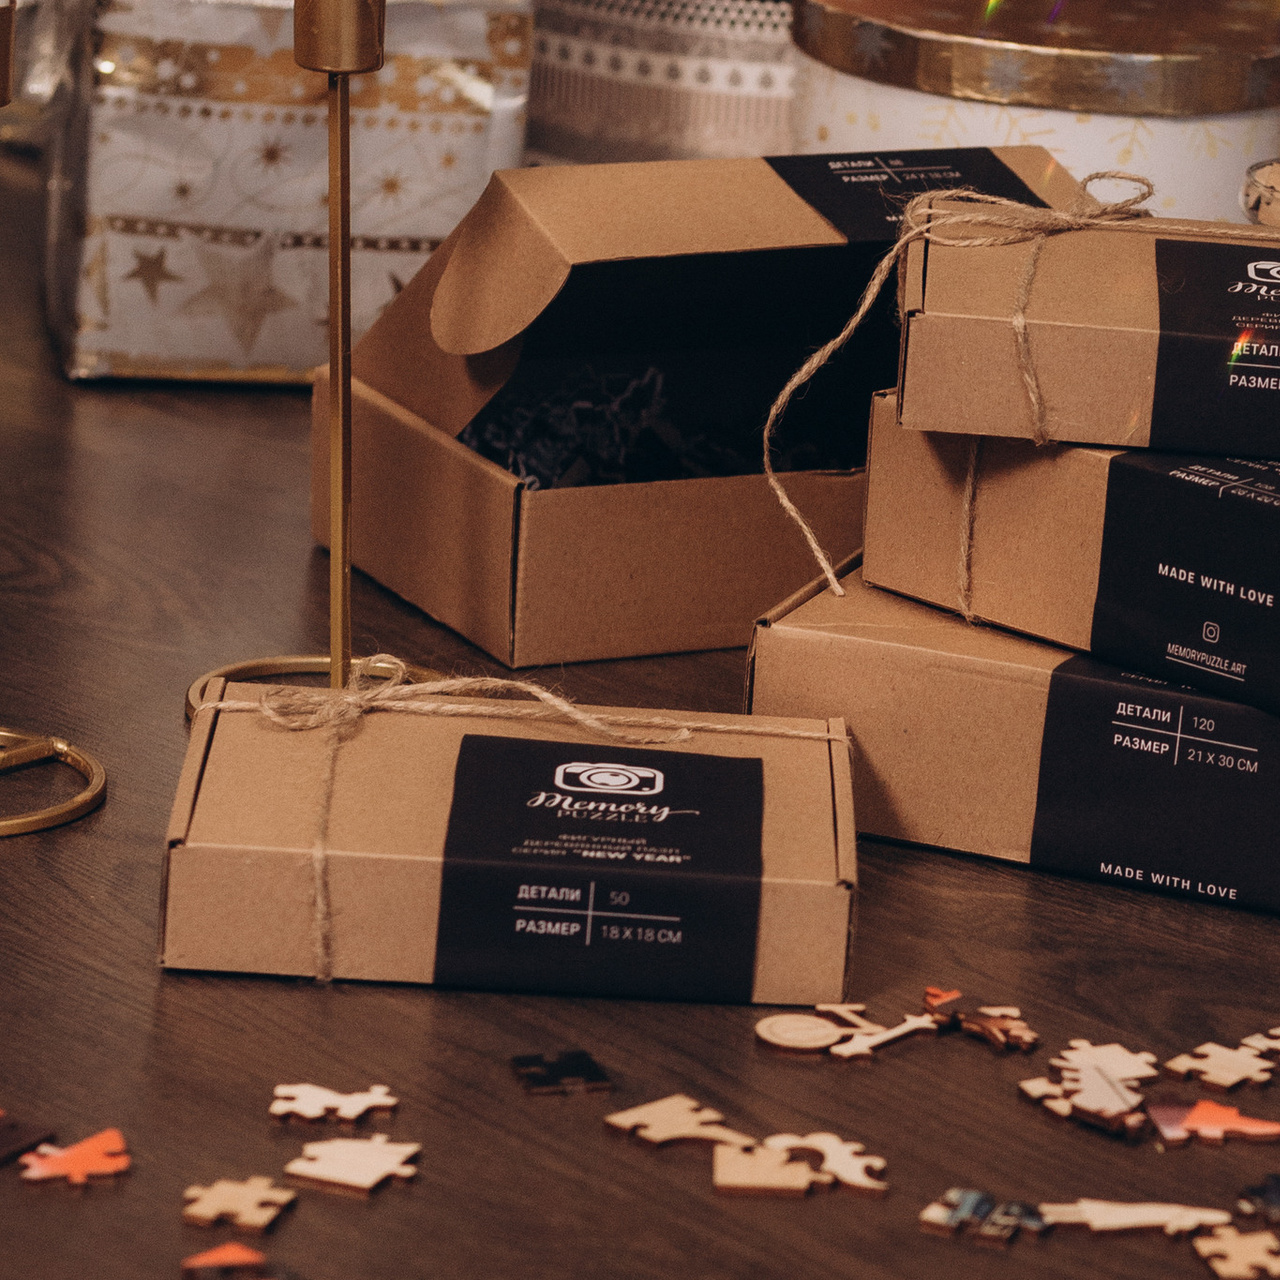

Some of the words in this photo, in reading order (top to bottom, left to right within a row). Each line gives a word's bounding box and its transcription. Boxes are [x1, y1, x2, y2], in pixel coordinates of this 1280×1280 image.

[1169, 469, 1221, 487] РАЗМЕР
[1158, 563, 1195, 584] MADE
[1200, 575, 1235, 595] WITH
[1239, 586, 1274, 607] LOVE
[1116, 702, 1171, 723] ДЕТАЛИ
[1192, 716, 1215, 732] 120
[1113, 733, 1170, 755] РАЗМЕР
[1187, 748, 1202, 762] 21
[1218, 754, 1234, 769] 30
[526, 791, 700, 822] Memory
[517, 884, 582, 902] ДЕТАЛИ
[609, 891, 631, 906] 50
[1100, 862, 1144, 881] MADE
[1150, 872, 1191, 891] WITH
[1197, 882, 1238, 900] LOVE
[515, 919, 582, 936] РАЗМЕР
[602, 925, 620, 939] 18
[638, 927, 655, 942] 18
